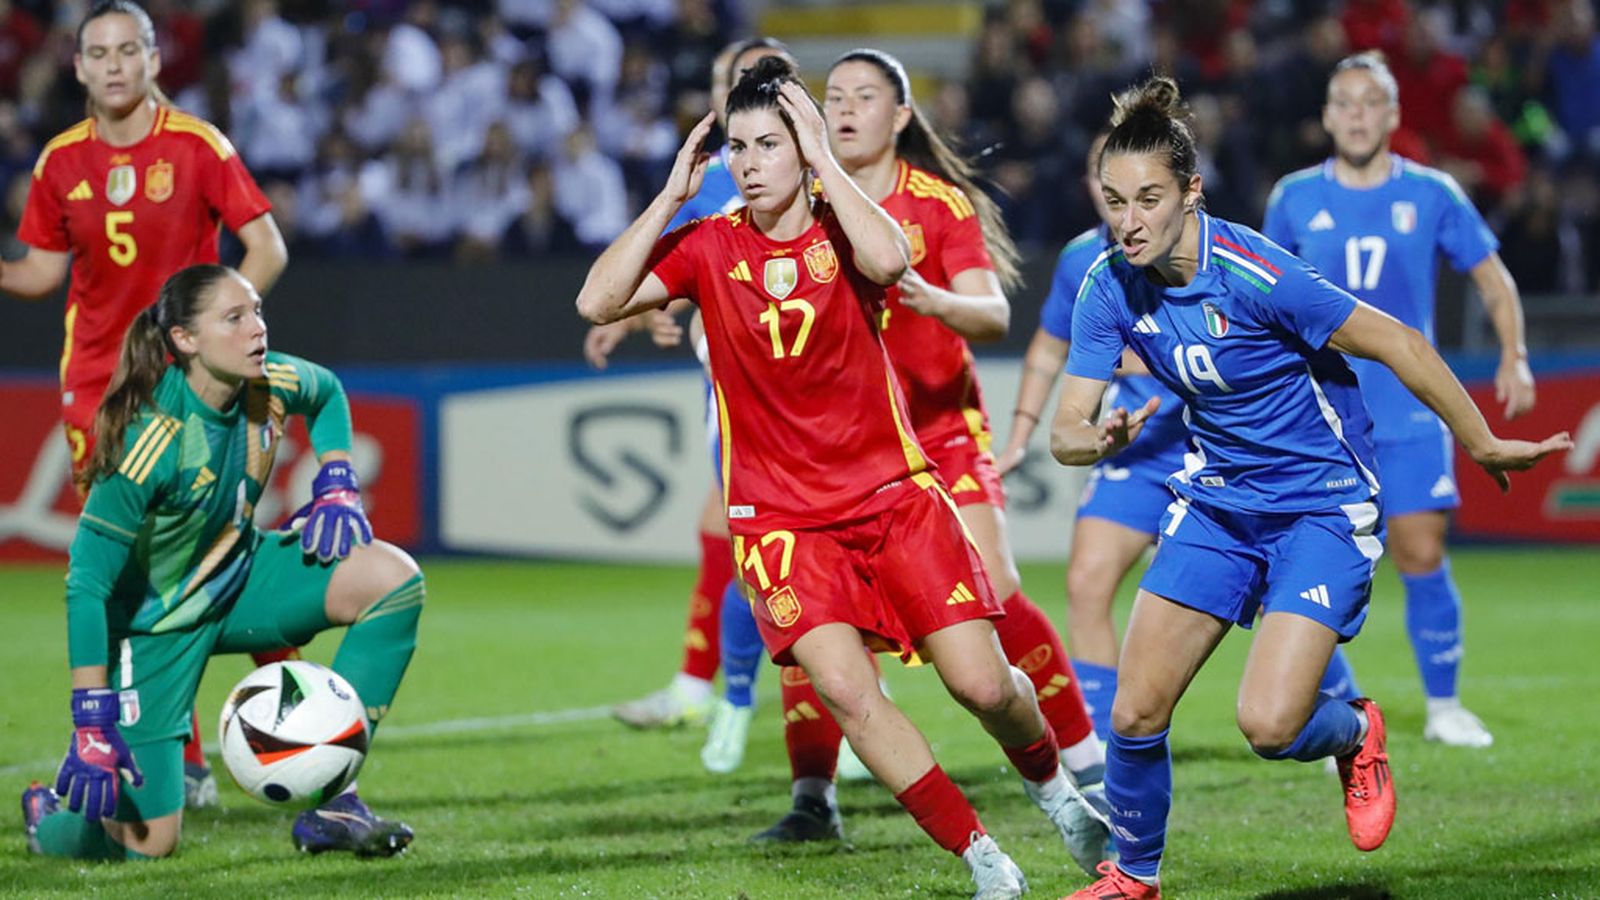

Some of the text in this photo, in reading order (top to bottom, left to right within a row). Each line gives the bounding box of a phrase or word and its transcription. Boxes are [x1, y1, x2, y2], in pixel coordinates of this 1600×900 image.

[105, 210, 138, 267] 5
[1344, 235, 1387, 291] 17
[759, 298, 816, 359] 17
[1173, 344, 1235, 395] 19
[743, 530, 796, 591] 17
